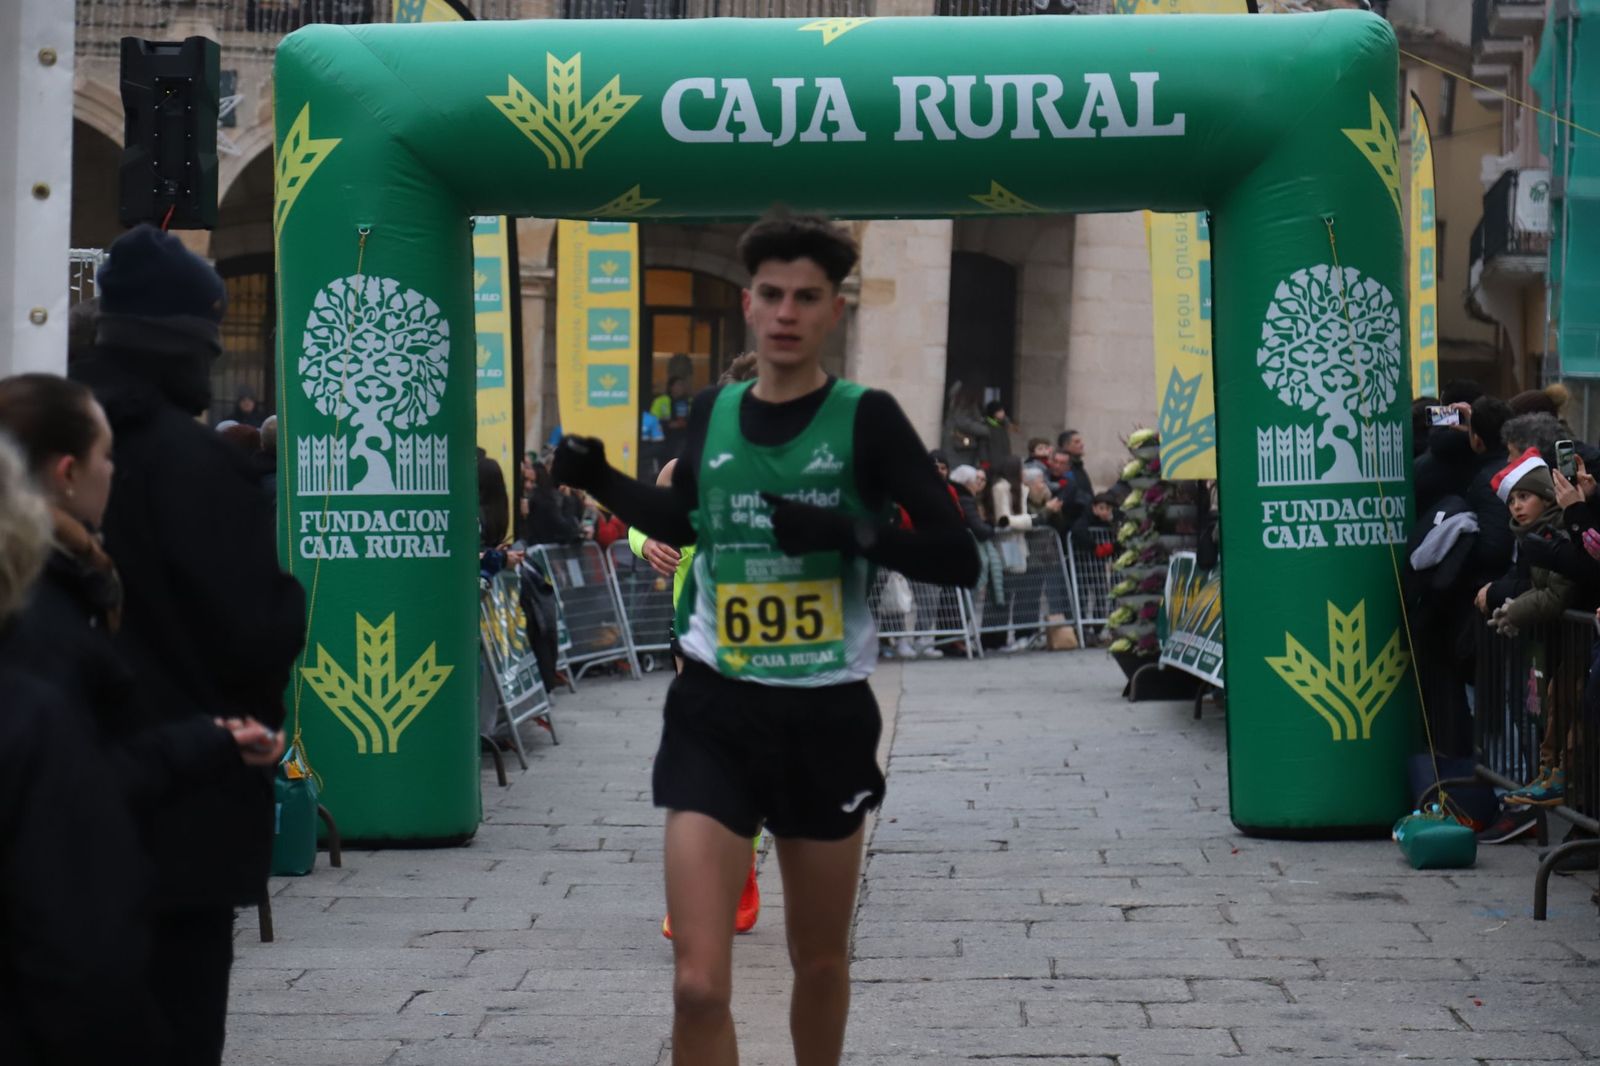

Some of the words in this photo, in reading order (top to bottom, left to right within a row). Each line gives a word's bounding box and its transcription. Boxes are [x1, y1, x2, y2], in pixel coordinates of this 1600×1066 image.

[661, 77, 866, 146] CAJA
[892, 72, 1186, 141] RURAL
[300, 509, 450, 533] FUNDACION
[1261, 496, 1406, 524] FUNDACION
[300, 535, 358, 560] CAJA
[365, 534, 451, 558] RURAL
[1262, 524, 1328, 550] CAJA
[1334, 521, 1408, 546] RURAL
[724, 593, 823, 644] 695
[752, 654, 786, 667] CAJA
[790, 650, 838, 666] RURAL
